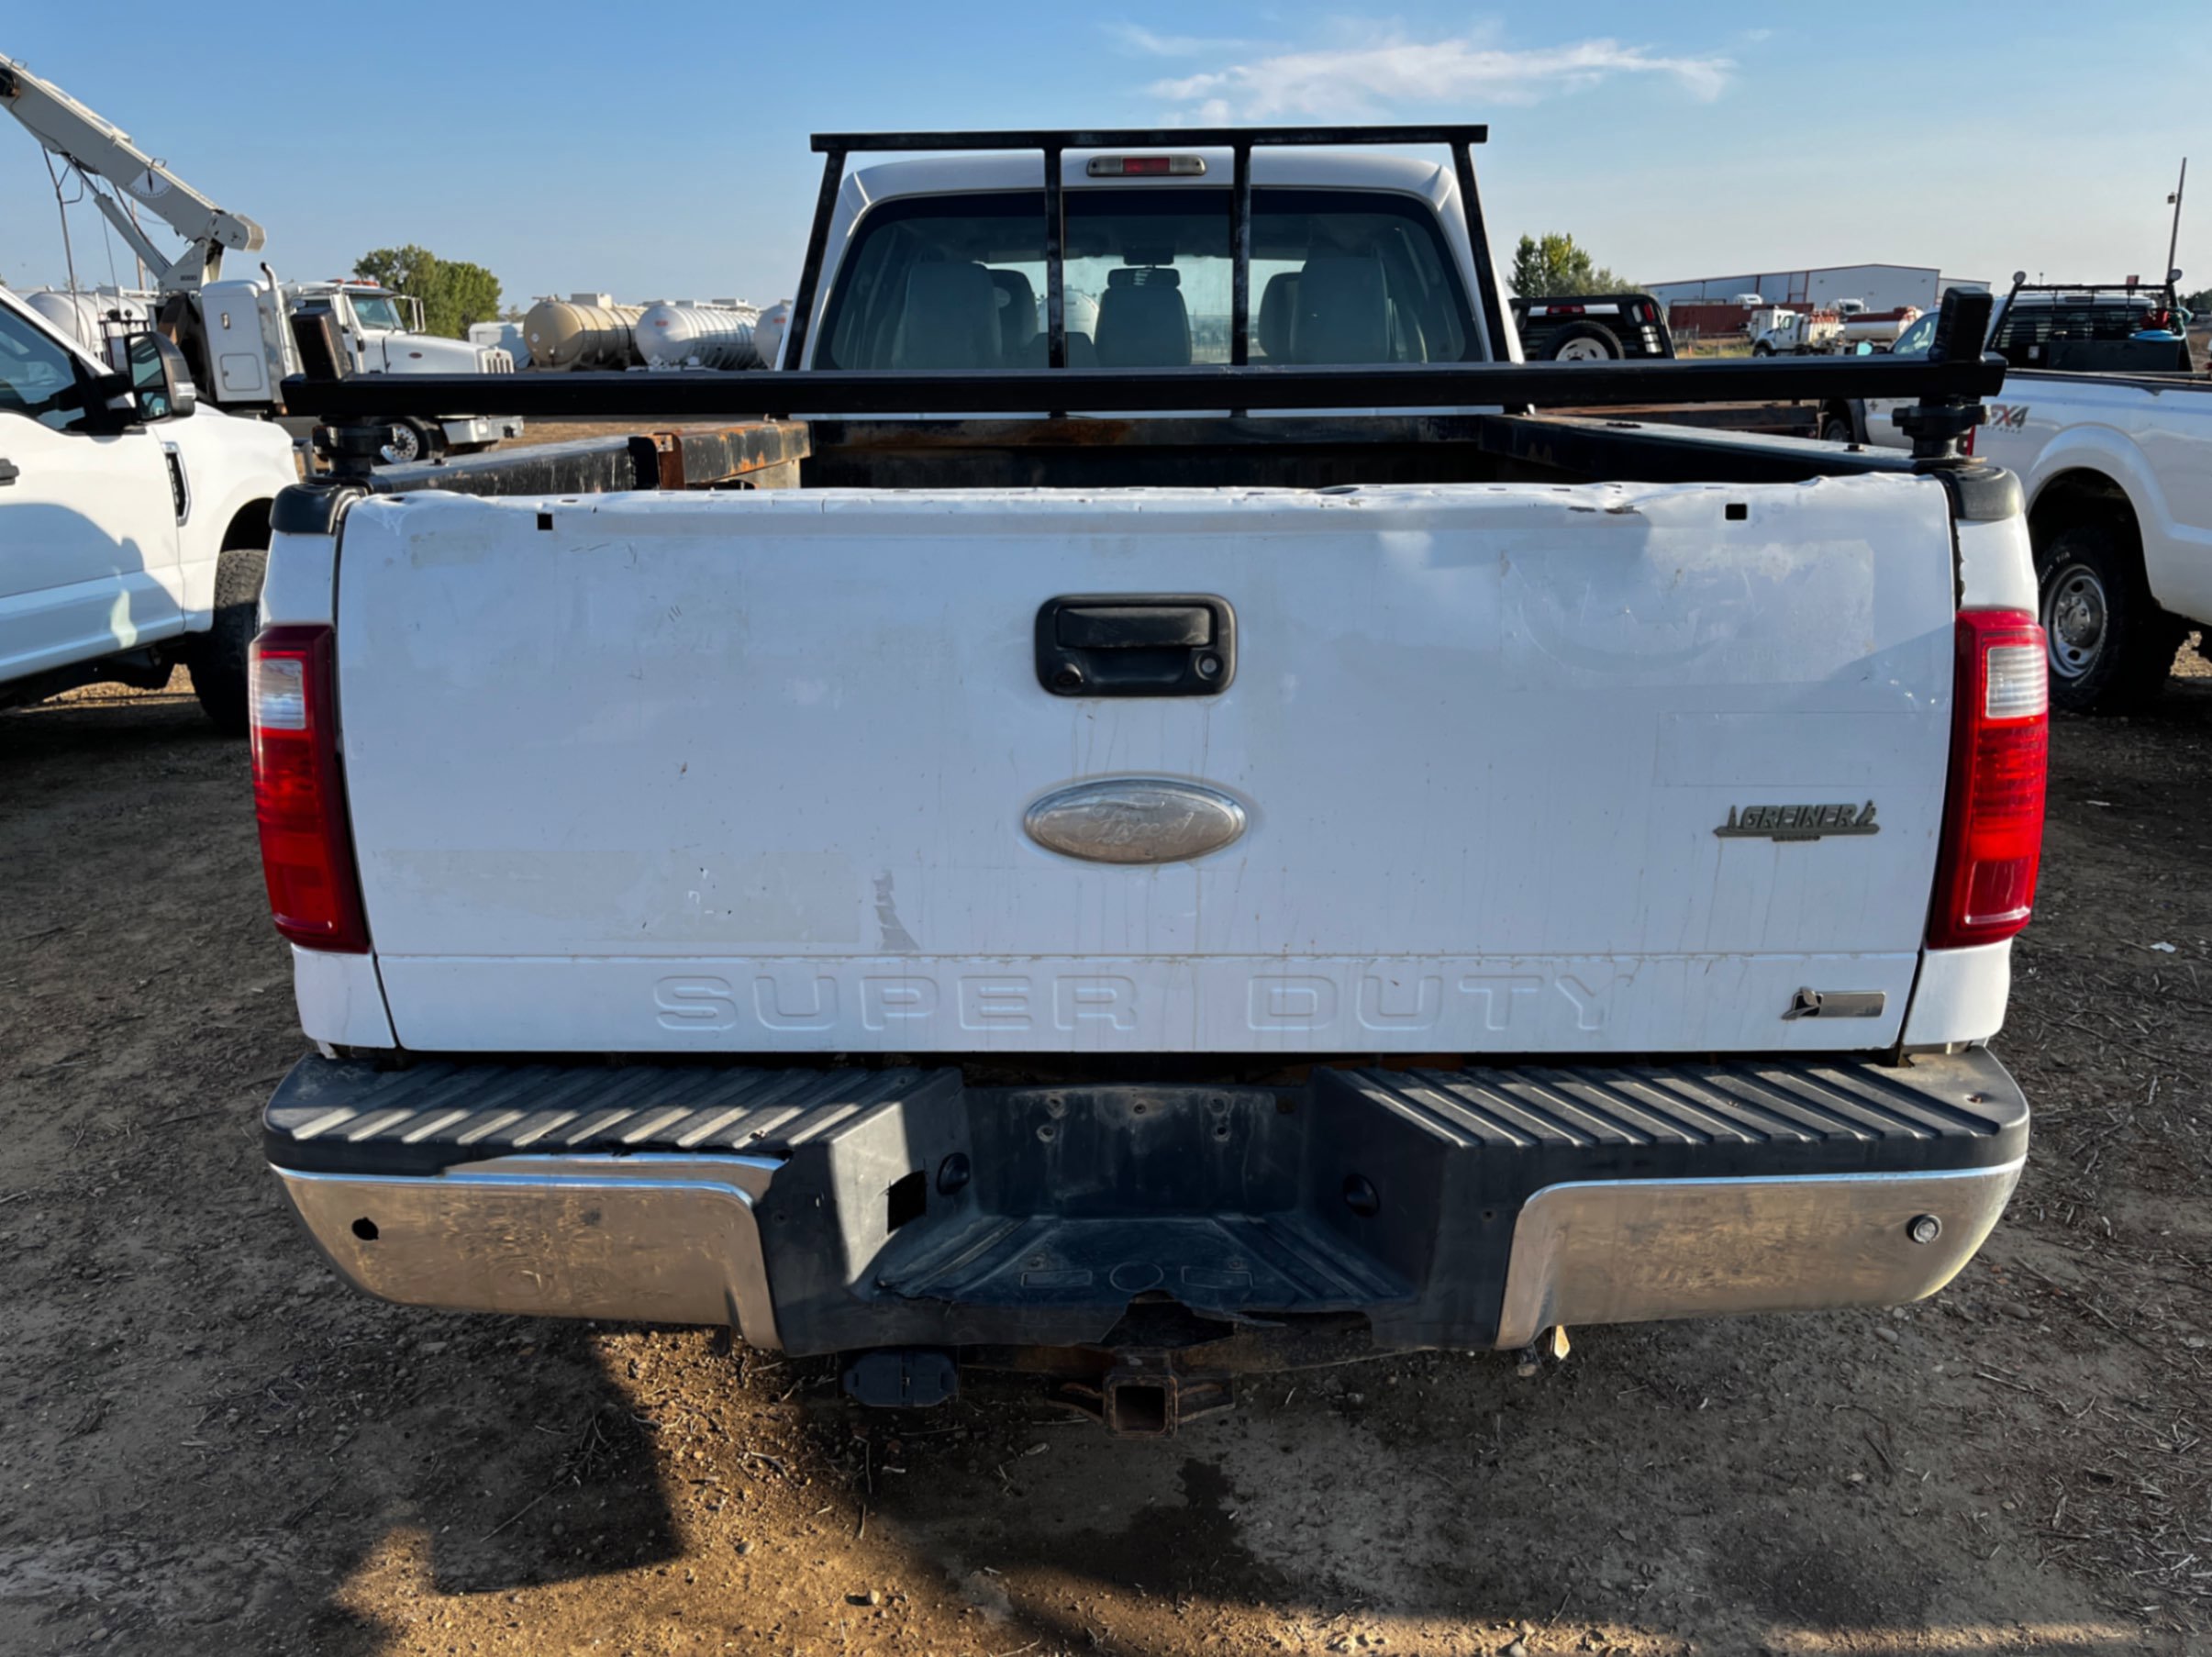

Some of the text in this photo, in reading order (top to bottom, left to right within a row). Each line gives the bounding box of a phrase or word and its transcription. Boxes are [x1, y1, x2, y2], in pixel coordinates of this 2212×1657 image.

[1740, 802, 1859, 830] GREINER
[652, 974, 1634, 1032] SUPER DUTY
